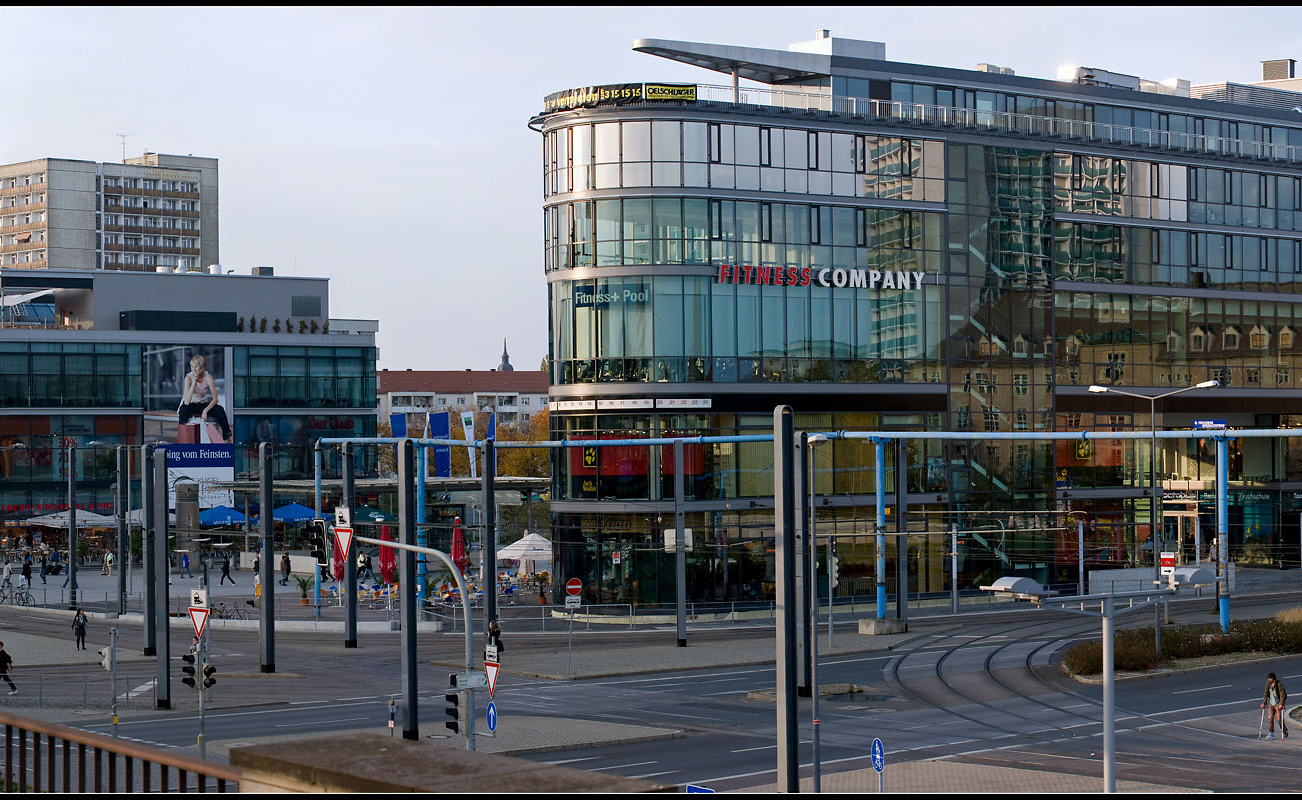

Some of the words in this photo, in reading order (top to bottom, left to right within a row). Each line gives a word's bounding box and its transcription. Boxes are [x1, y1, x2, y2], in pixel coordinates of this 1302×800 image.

[720, 265, 811, 286] FITNESS
[818, 268, 926, 290] COMPANY
[623, 289, 648, 302] Pool
[330, 416, 354, 429] Club
[181, 451, 198, 459] vom
[199, 449, 232, 459] Feinsten.
